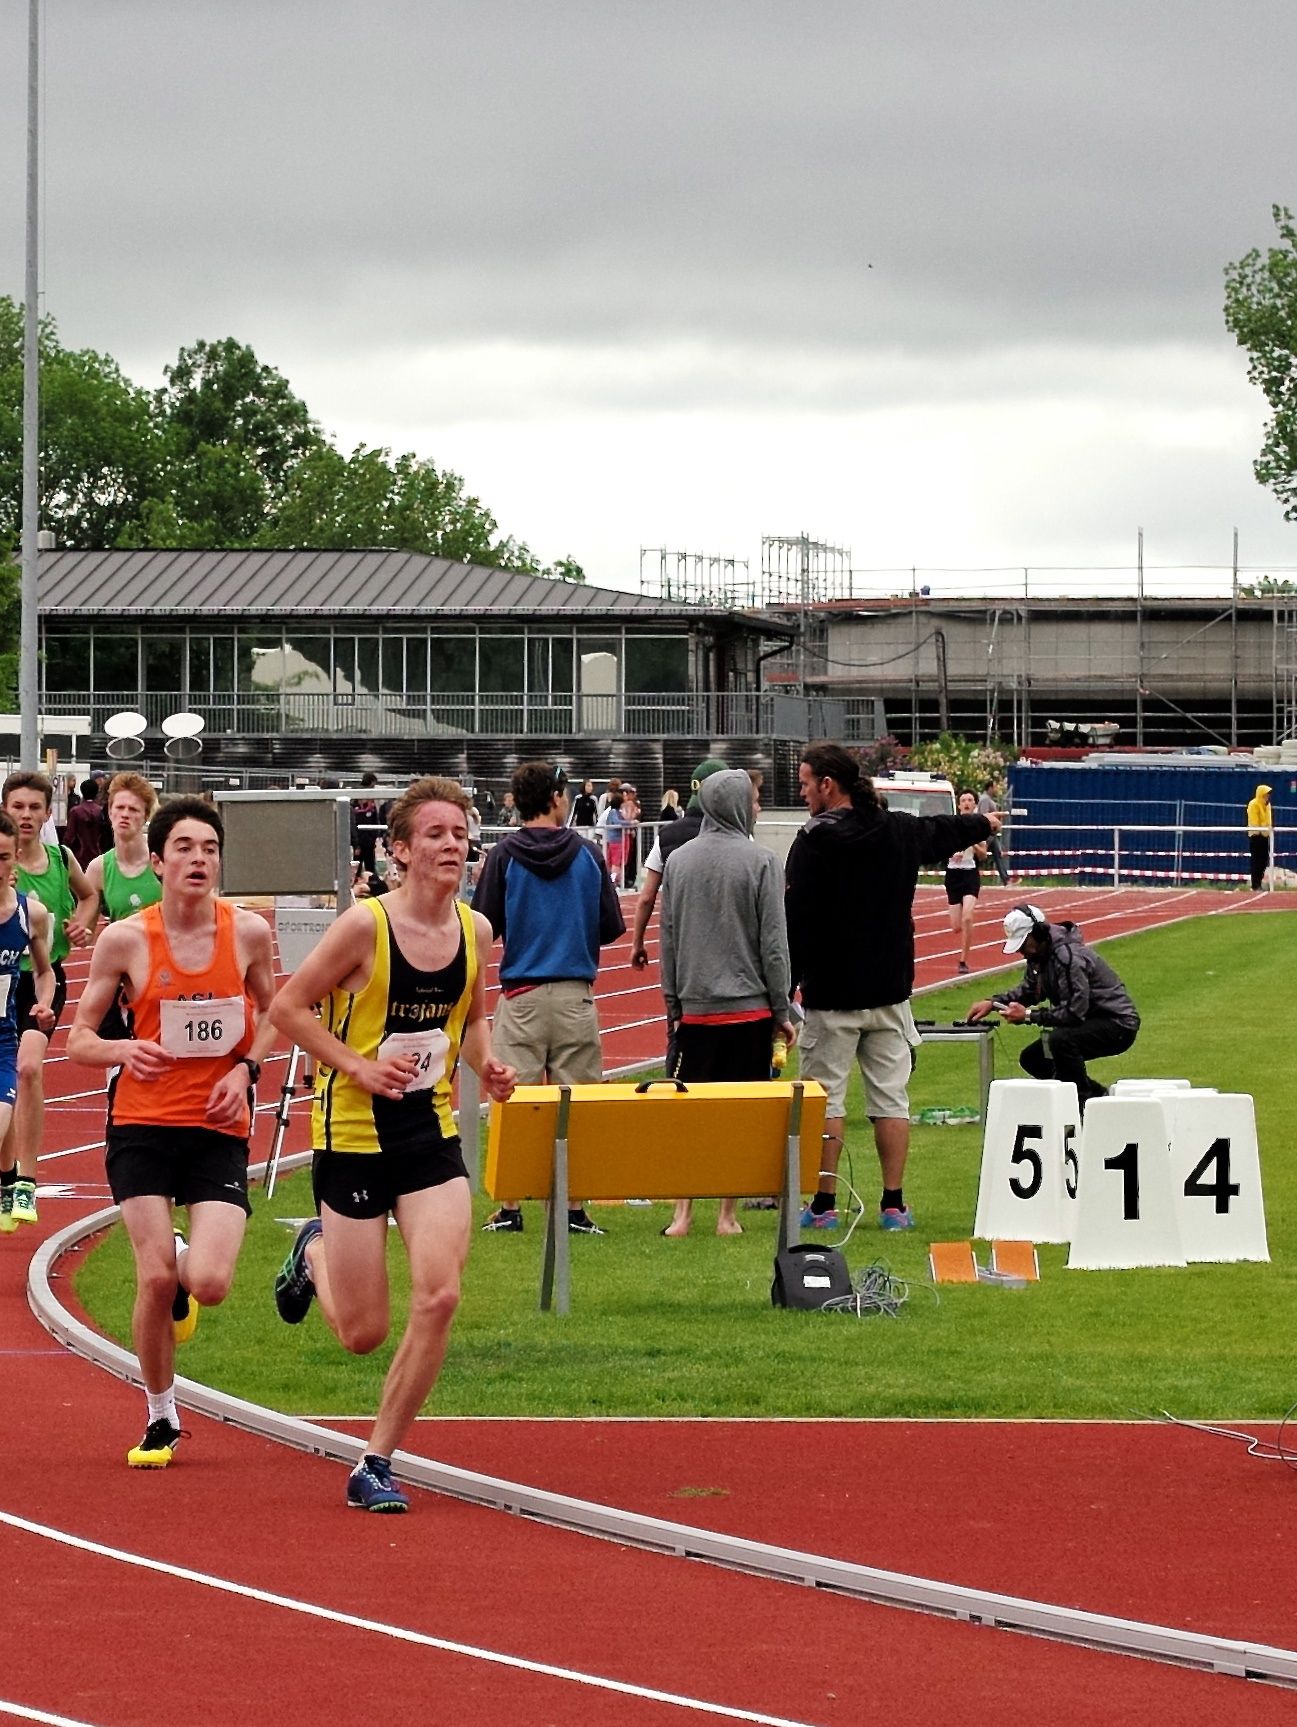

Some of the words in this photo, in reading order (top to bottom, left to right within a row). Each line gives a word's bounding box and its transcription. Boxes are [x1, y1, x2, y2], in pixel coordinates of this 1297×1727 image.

[184, 1019, 223, 1041] 186
[1008, 1124, 1044, 1199] 5
[1064, 1124, 1079, 1199] 5
[1104, 1142, 1140, 1220] 1
[1184, 1138, 1241, 1214] 4
